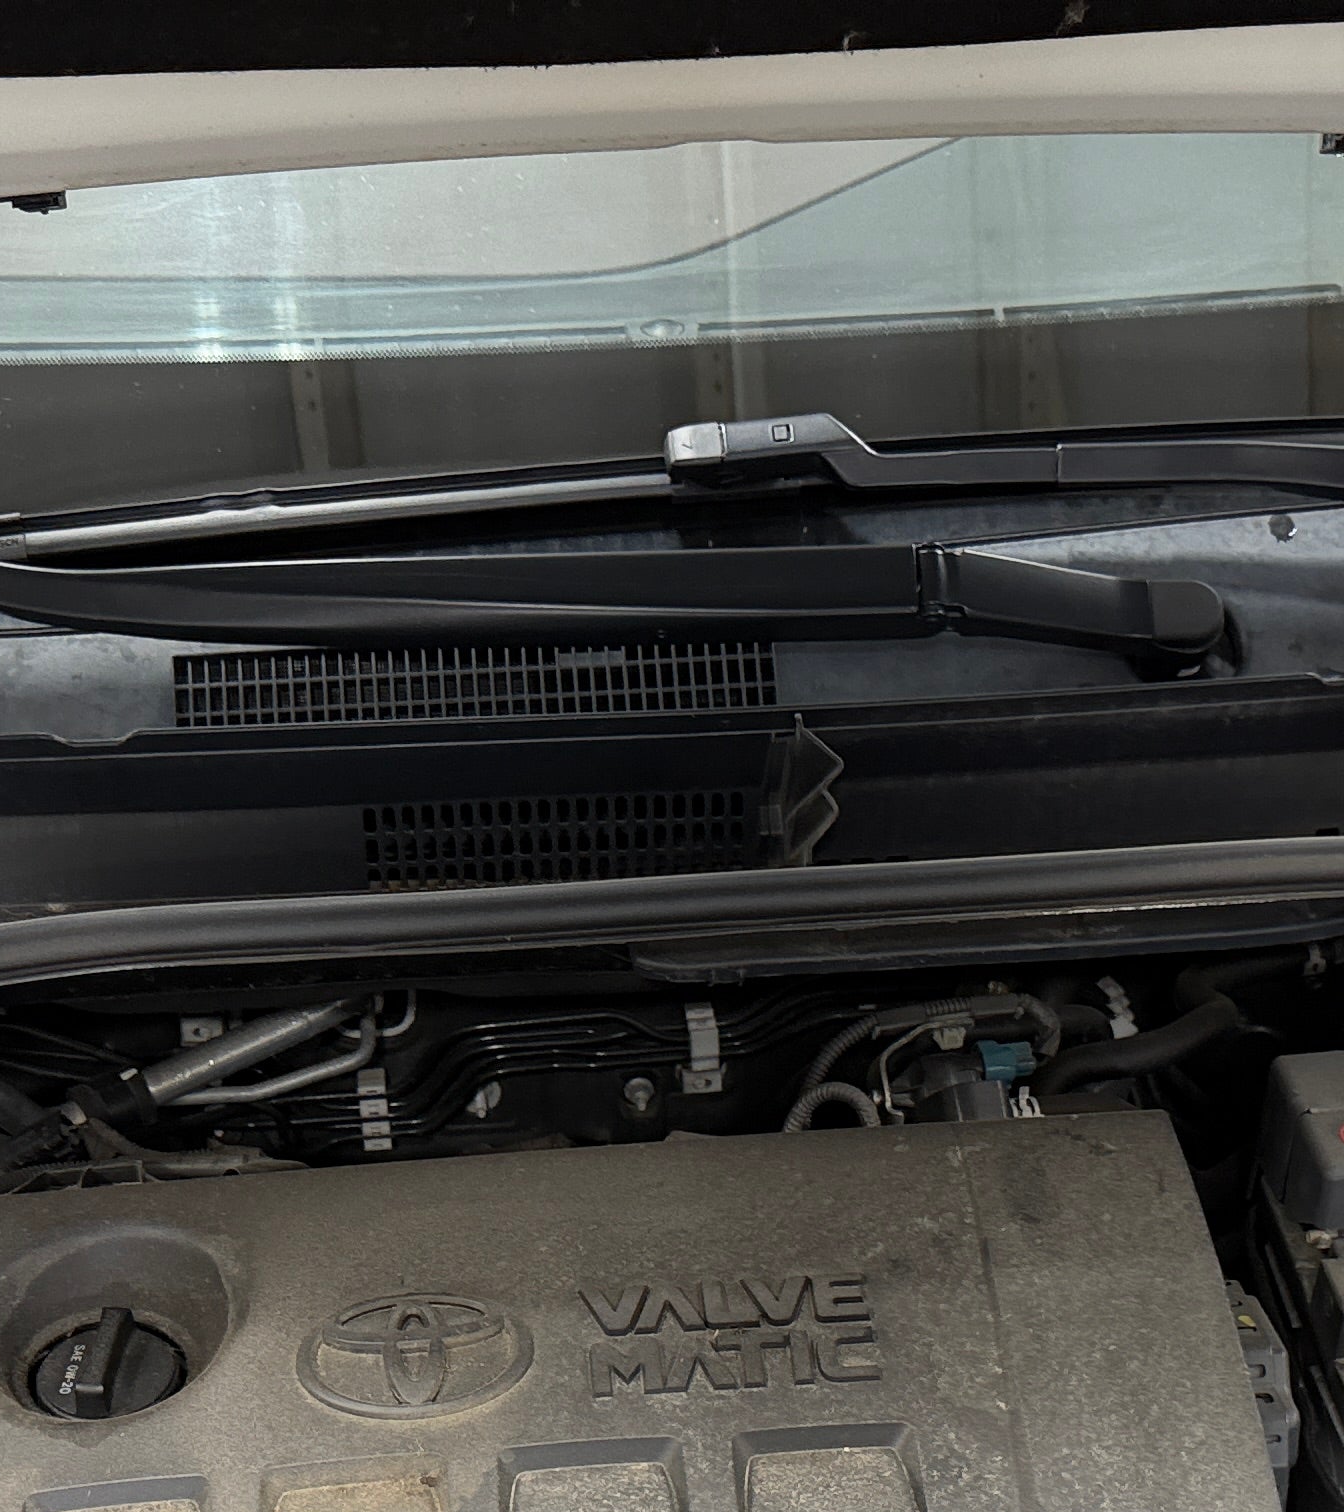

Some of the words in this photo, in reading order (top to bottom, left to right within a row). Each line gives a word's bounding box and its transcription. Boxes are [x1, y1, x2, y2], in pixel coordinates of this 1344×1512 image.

[577, 1272, 875, 1338] VALVE
[70, 1344, 86, 1363] SAE
[588, 1327, 883, 1399] MATIC
[59, 1364, 81, 1395] 0W-20
